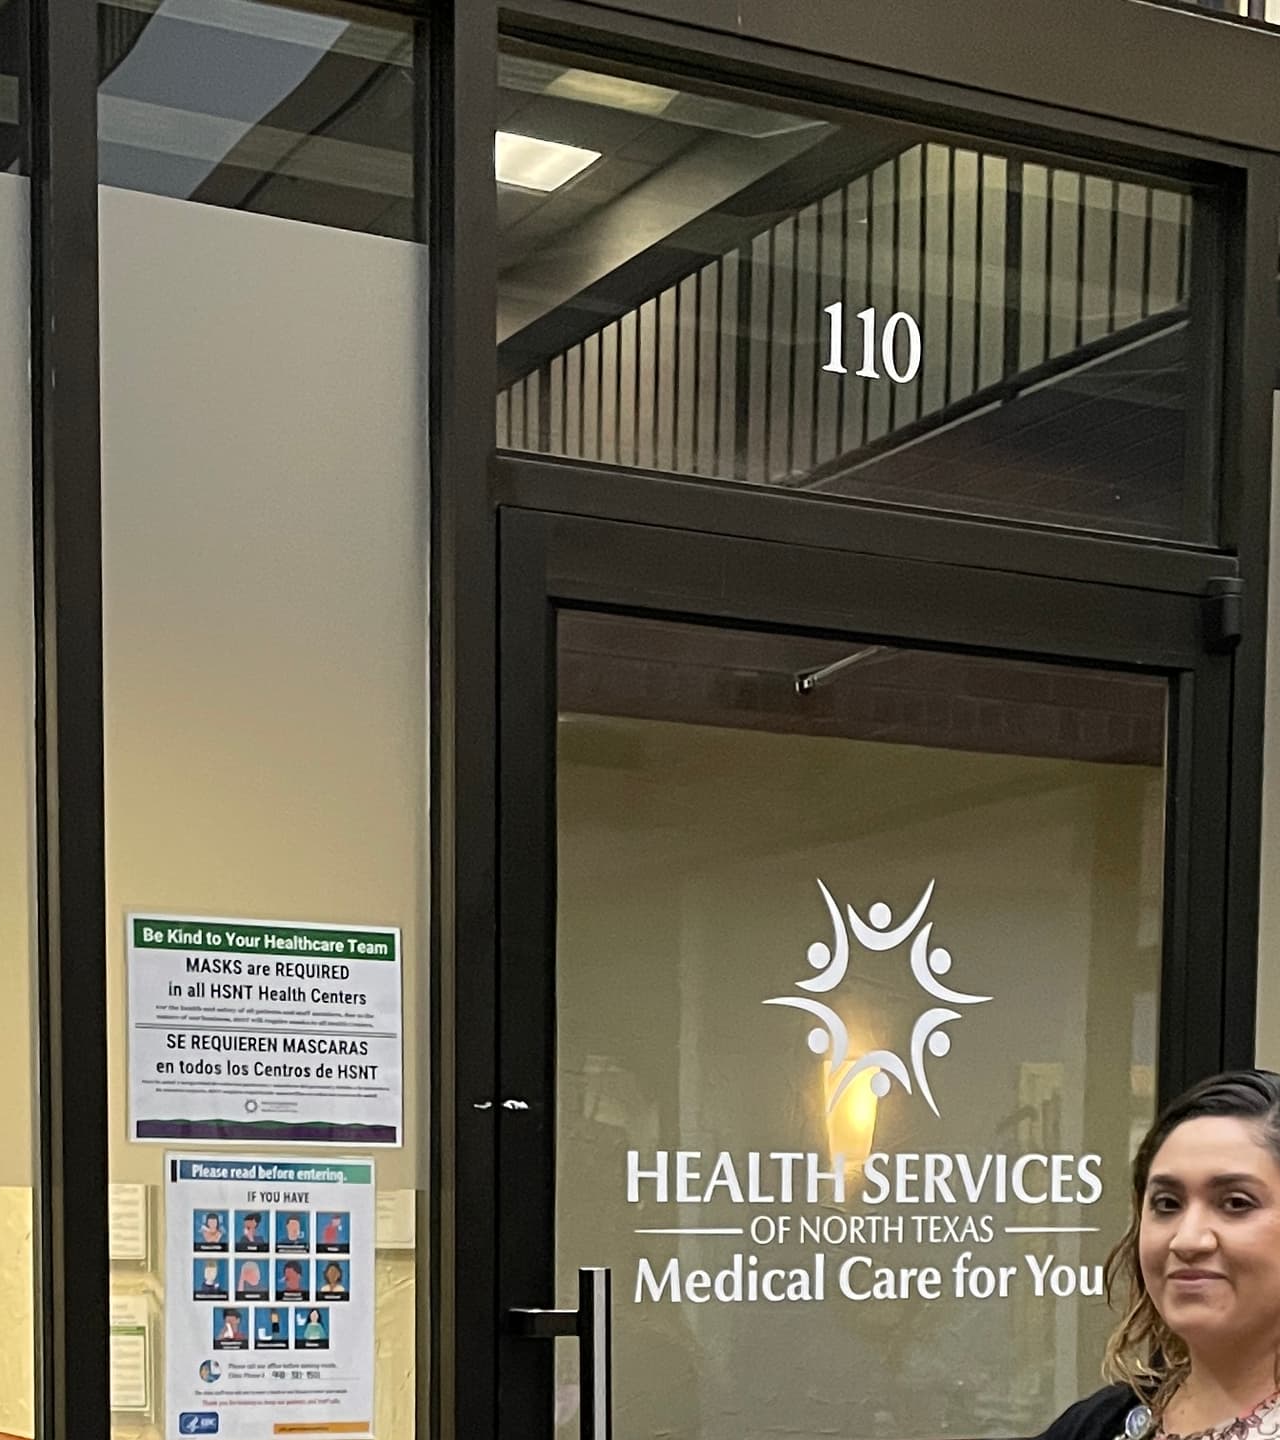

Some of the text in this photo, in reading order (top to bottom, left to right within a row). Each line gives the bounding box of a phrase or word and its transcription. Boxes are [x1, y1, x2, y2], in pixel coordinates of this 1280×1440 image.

[822, 301, 921, 384] 110
[143, 927, 388, 955] Be Kind to Your Healthcare Team
[186, 957, 350, 980] MASKS are REQUIRED
[168, 981, 367, 1005] in all HSNT Health Centers
[167, 1033, 368, 1056] SE REQUIEREN MASCARAS
[156, 1059, 379, 1080] en todos los Centros de HSNT
[192, 1163, 348, 1184] Please read before entering.
[626, 1151, 1104, 1204] HEALTH SERVICES
[247, 1191, 310, 1204] IF YOU HAVE
[750, 1215, 994, 1246] OF NORTH TEXAS
[633, 1251, 1106, 1304] Medical Care for You
